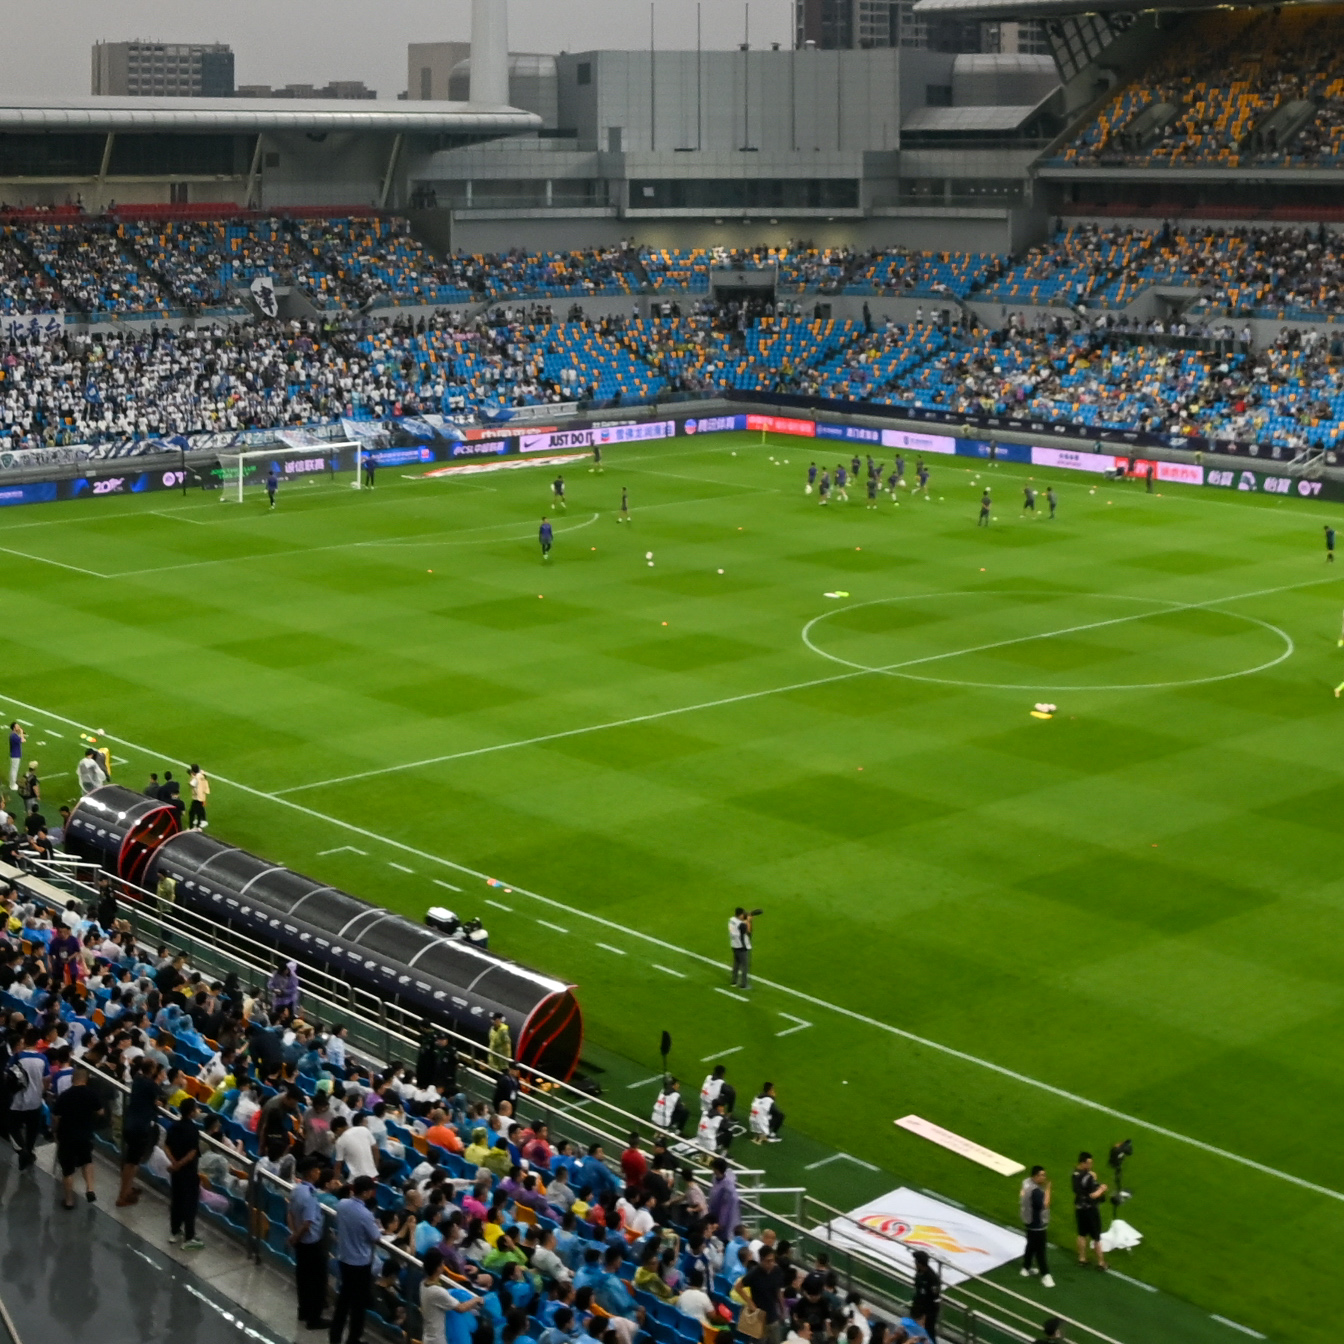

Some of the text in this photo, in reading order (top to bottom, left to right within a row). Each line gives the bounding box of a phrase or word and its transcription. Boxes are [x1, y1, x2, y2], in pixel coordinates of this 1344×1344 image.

[5, 317, 61, 341] 北看台
[548, 433, 570, 448] JUST
[571, 431, 584, 446] DO
[285, 458, 324, 473] 诚信联赛
